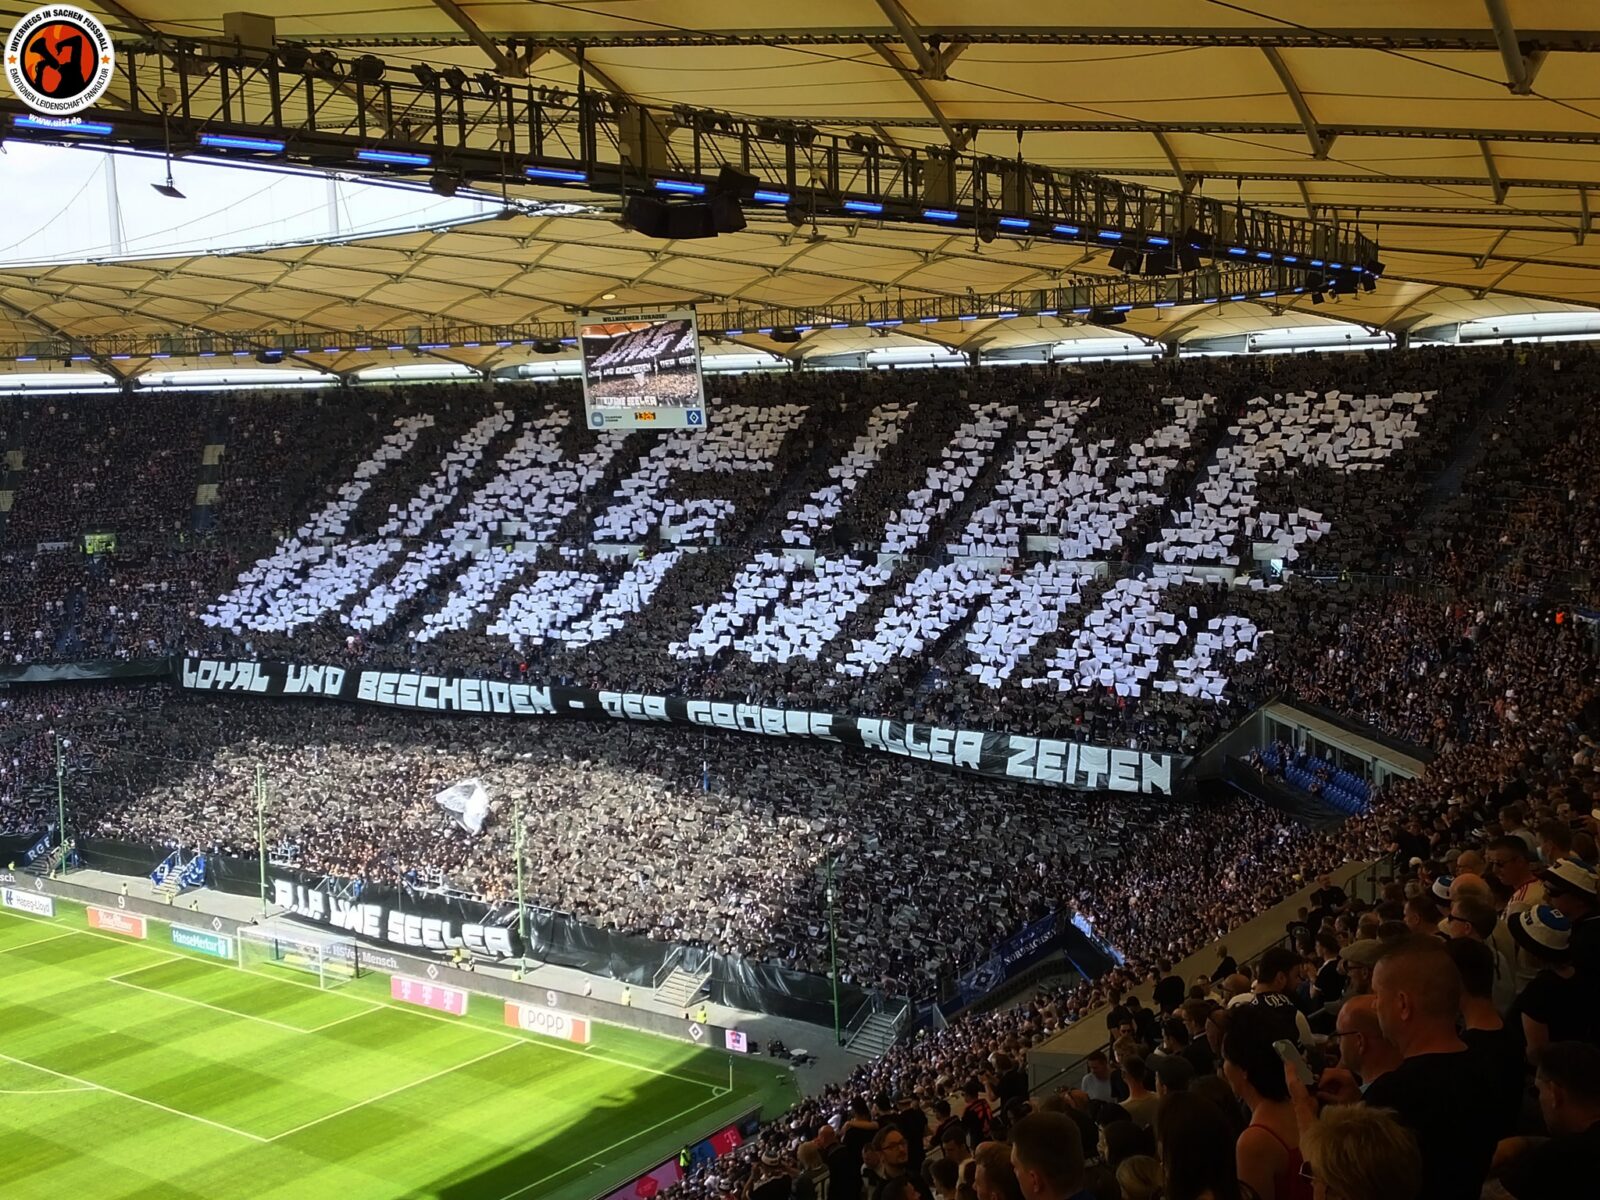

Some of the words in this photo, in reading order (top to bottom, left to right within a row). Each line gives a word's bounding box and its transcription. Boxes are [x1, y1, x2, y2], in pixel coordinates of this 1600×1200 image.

[183, 658, 268, 692] LOYAL
[282, 664, 345, 696] UND
[356, 670, 557, 714] BESCHEIDEN
[599, 691, 671, 723] DER
[857, 717, 982, 771] ALLER
[1005, 735, 1172, 796] ZEITEN
[118, 896, 126, 909] 9
[328, 896, 382, 939] UWE
[387, 909, 514, 958] SEELER
[172, 929, 218, 952] HanseMerkur
[362, 952, 400, 969] Mensch.
[546, 990, 558, 1007] 9
[527, 1009, 564, 1035] popp
